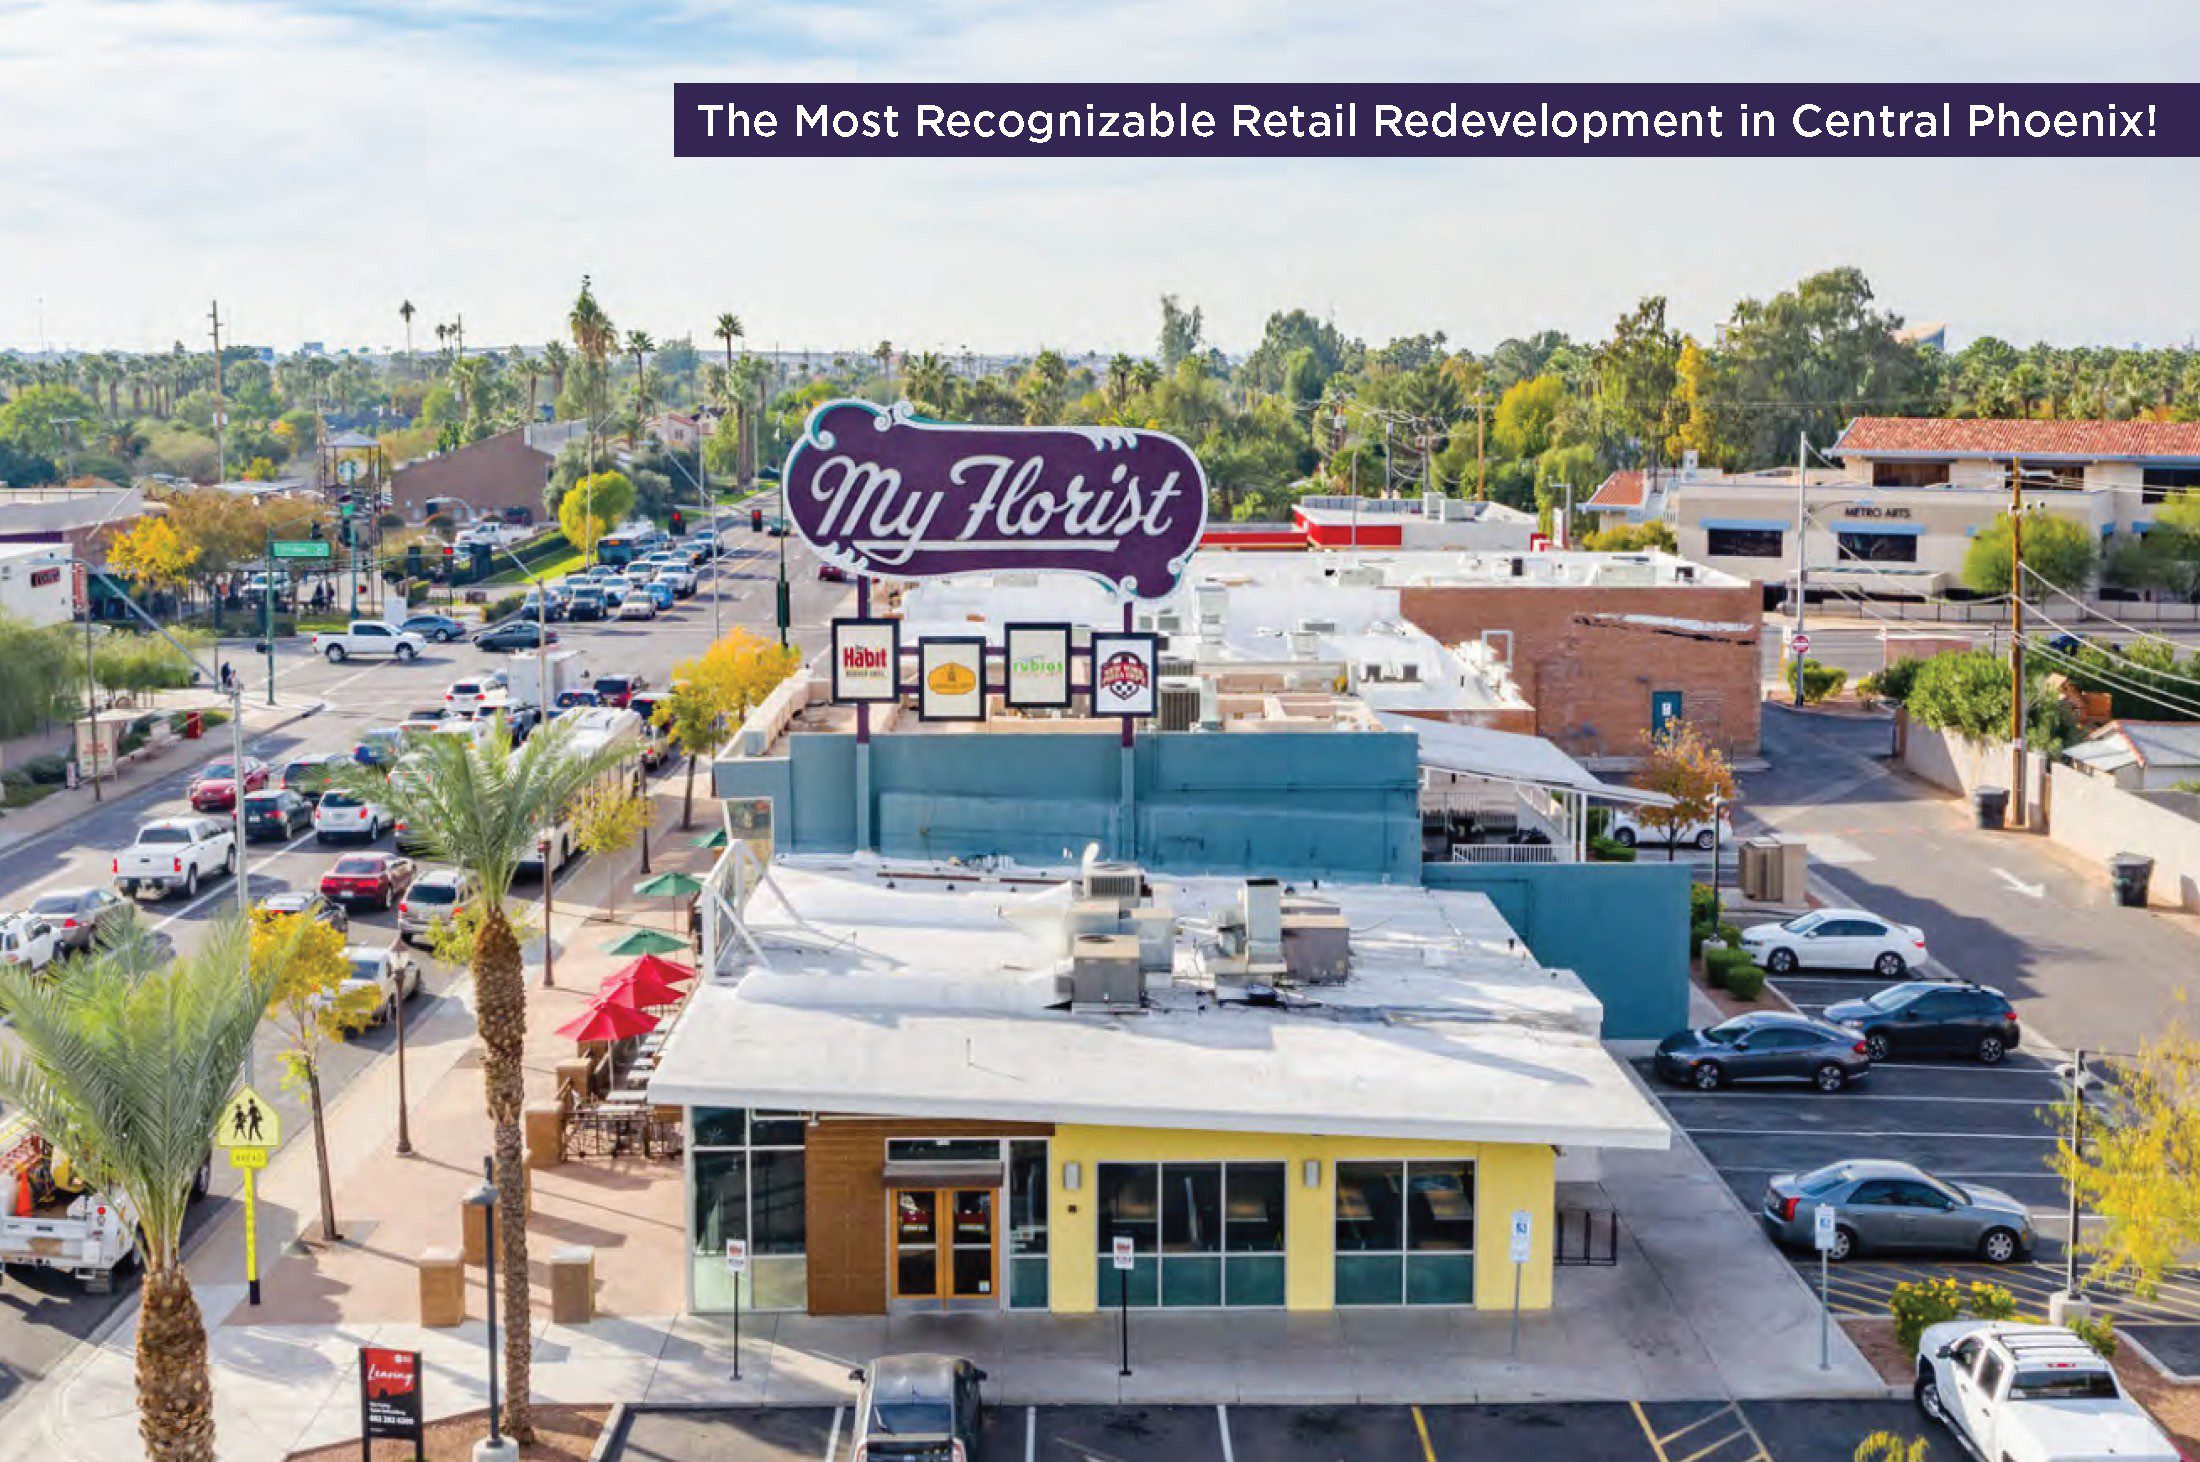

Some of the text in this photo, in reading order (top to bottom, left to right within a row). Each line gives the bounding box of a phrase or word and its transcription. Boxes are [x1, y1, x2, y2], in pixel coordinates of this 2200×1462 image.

[811, 455, 1182, 565] My Florist
[1844, 507, 1911, 518] METRO ARTS
[843, 647, 887, 668] Habit
[368, 1364, 415, 1388] Leasing
